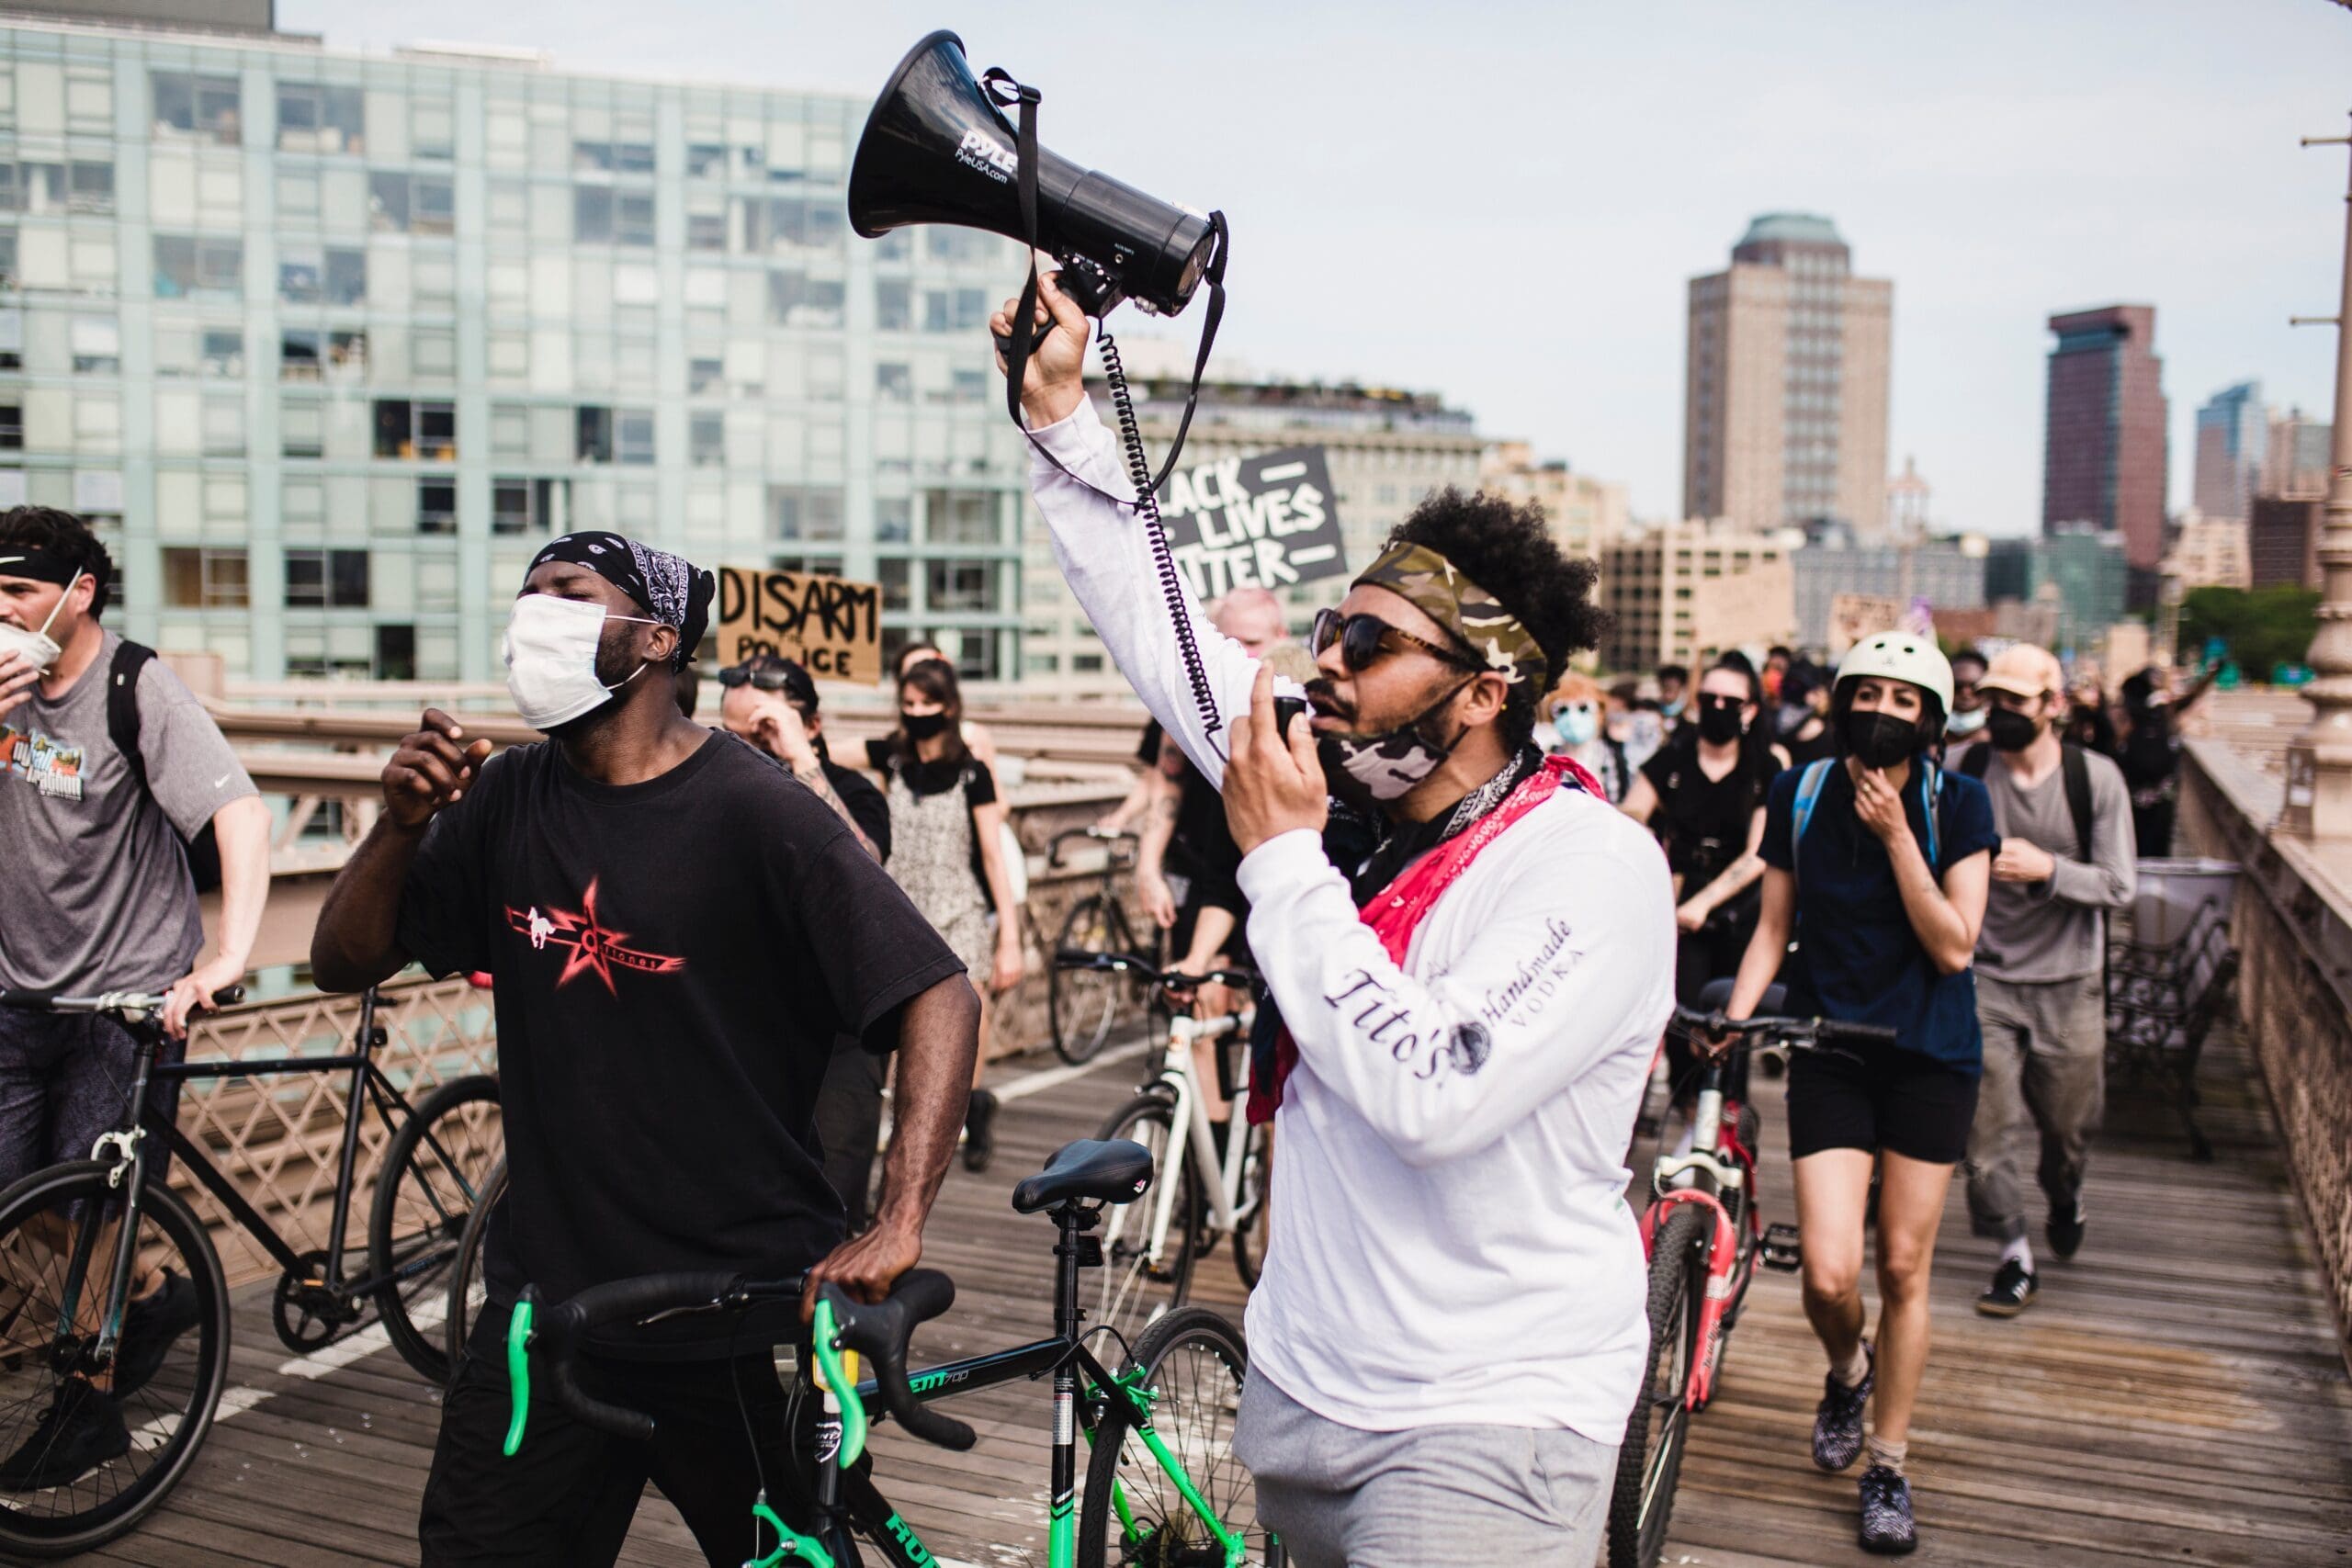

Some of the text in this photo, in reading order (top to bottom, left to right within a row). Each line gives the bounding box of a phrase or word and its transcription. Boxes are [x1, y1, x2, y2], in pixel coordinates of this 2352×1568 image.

[956, 148, 1008, 184] PyleUSA.com
[961, 130, 1019, 174] PYLE
[1150, 456, 1250, 517] LACK
[1196, 482, 1326, 549] LIVES
[1172, 538, 1300, 598] TTER
[719, 568, 876, 643] DISARM
[1481, 917, 1572, 1028] Handmade
[1511, 949, 1585, 1027] VODKA
